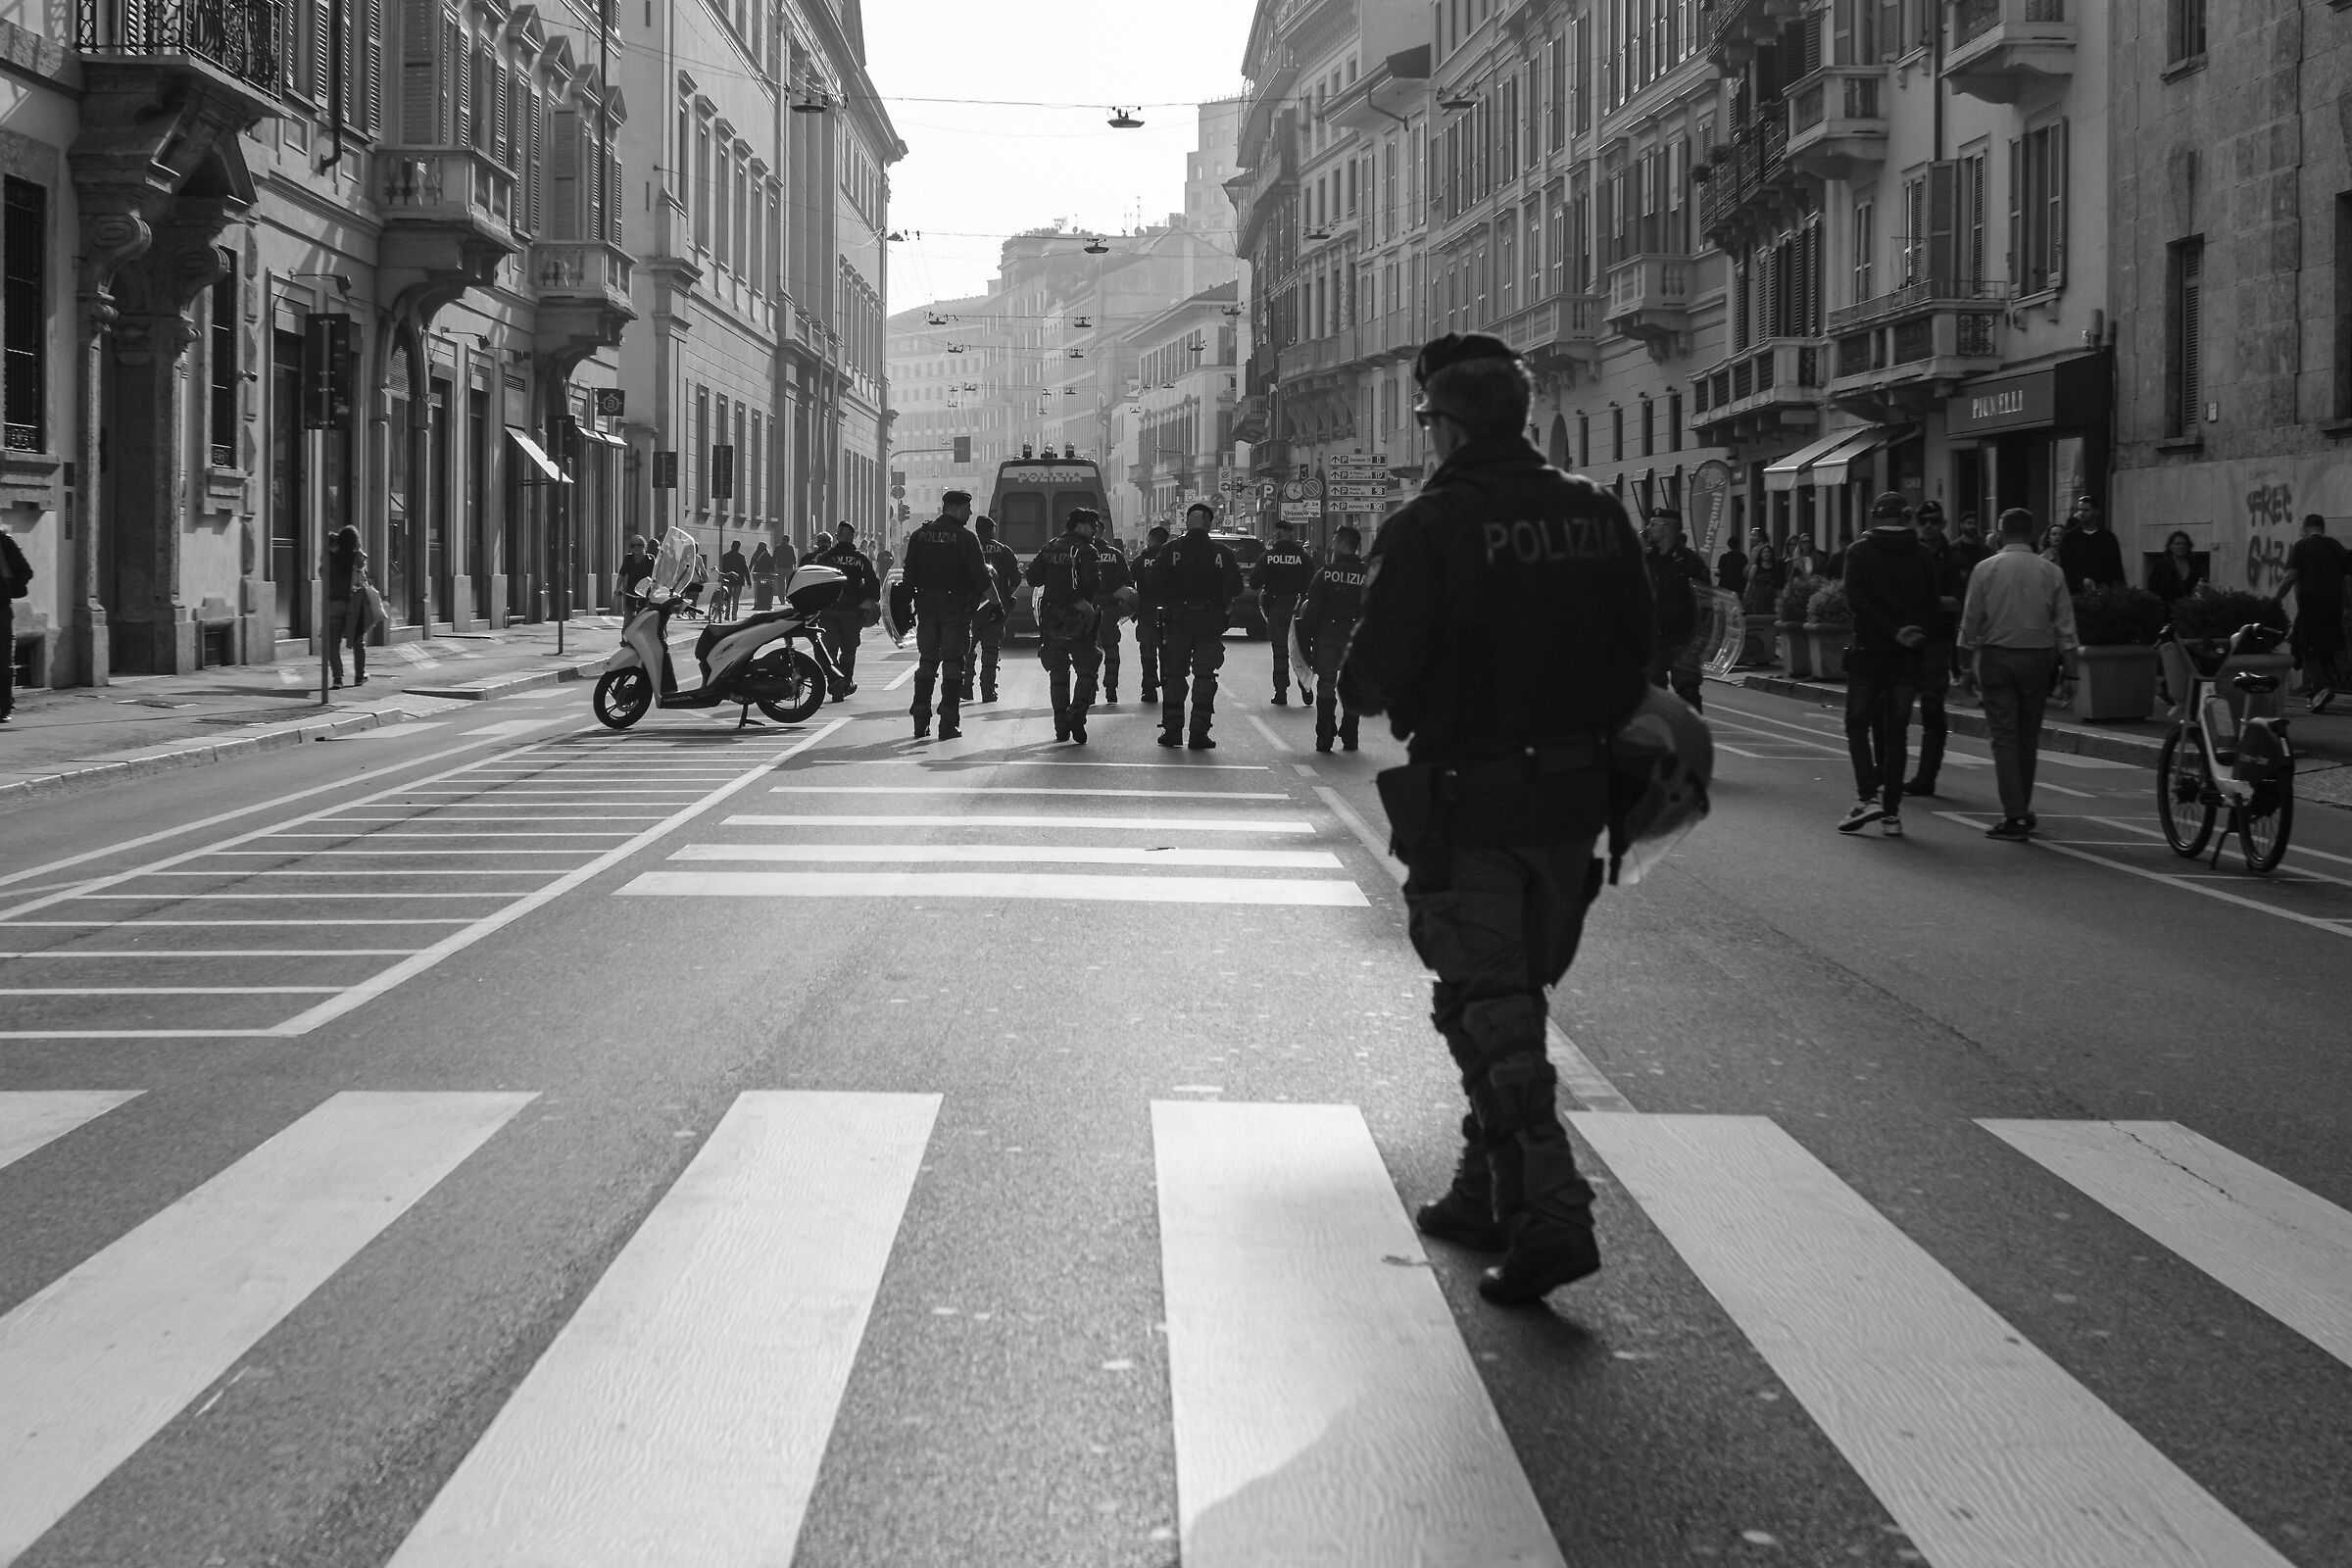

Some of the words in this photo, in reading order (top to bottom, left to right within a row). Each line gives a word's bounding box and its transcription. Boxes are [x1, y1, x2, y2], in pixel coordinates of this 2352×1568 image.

[1017, 472, 1082, 483] POLIZIA
[1264, 484, 1274, 498] P
[918, 531, 957, 544] POLIZIA
[1482, 517, 1622, 566] POLIZIA
[981, 544, 1003, 555] LIZIA
[1267, 555, 1302, 565] POLIZIA
